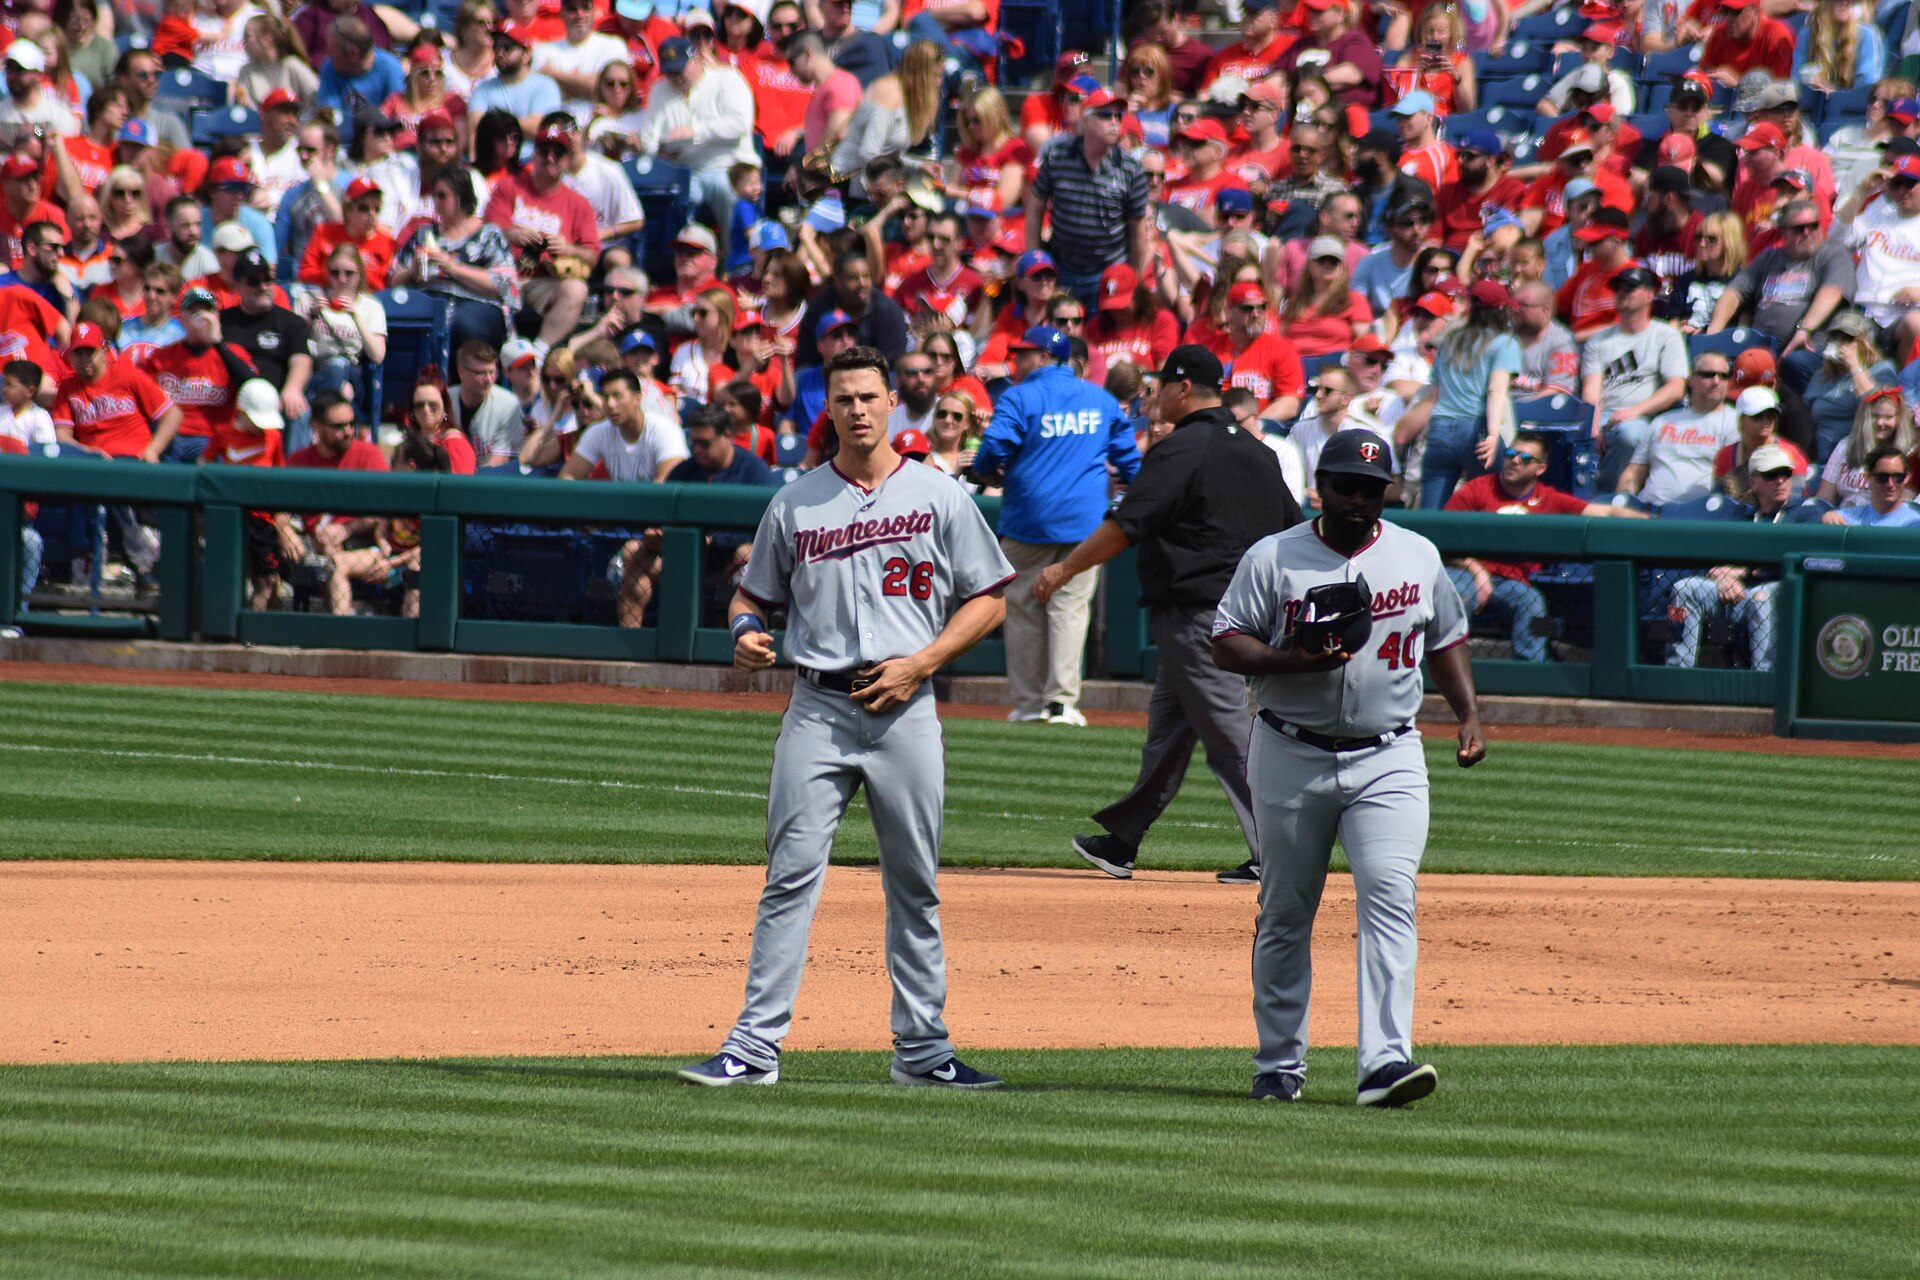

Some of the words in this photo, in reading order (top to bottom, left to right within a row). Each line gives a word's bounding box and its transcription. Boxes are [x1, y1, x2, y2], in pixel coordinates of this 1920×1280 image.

[1040, 410, 1102, 439] STAFF
[793, 508, 934, 563] Minnesota
[882, 556, 934, 601] 26
[1377, 628, 1417, 671] 40
